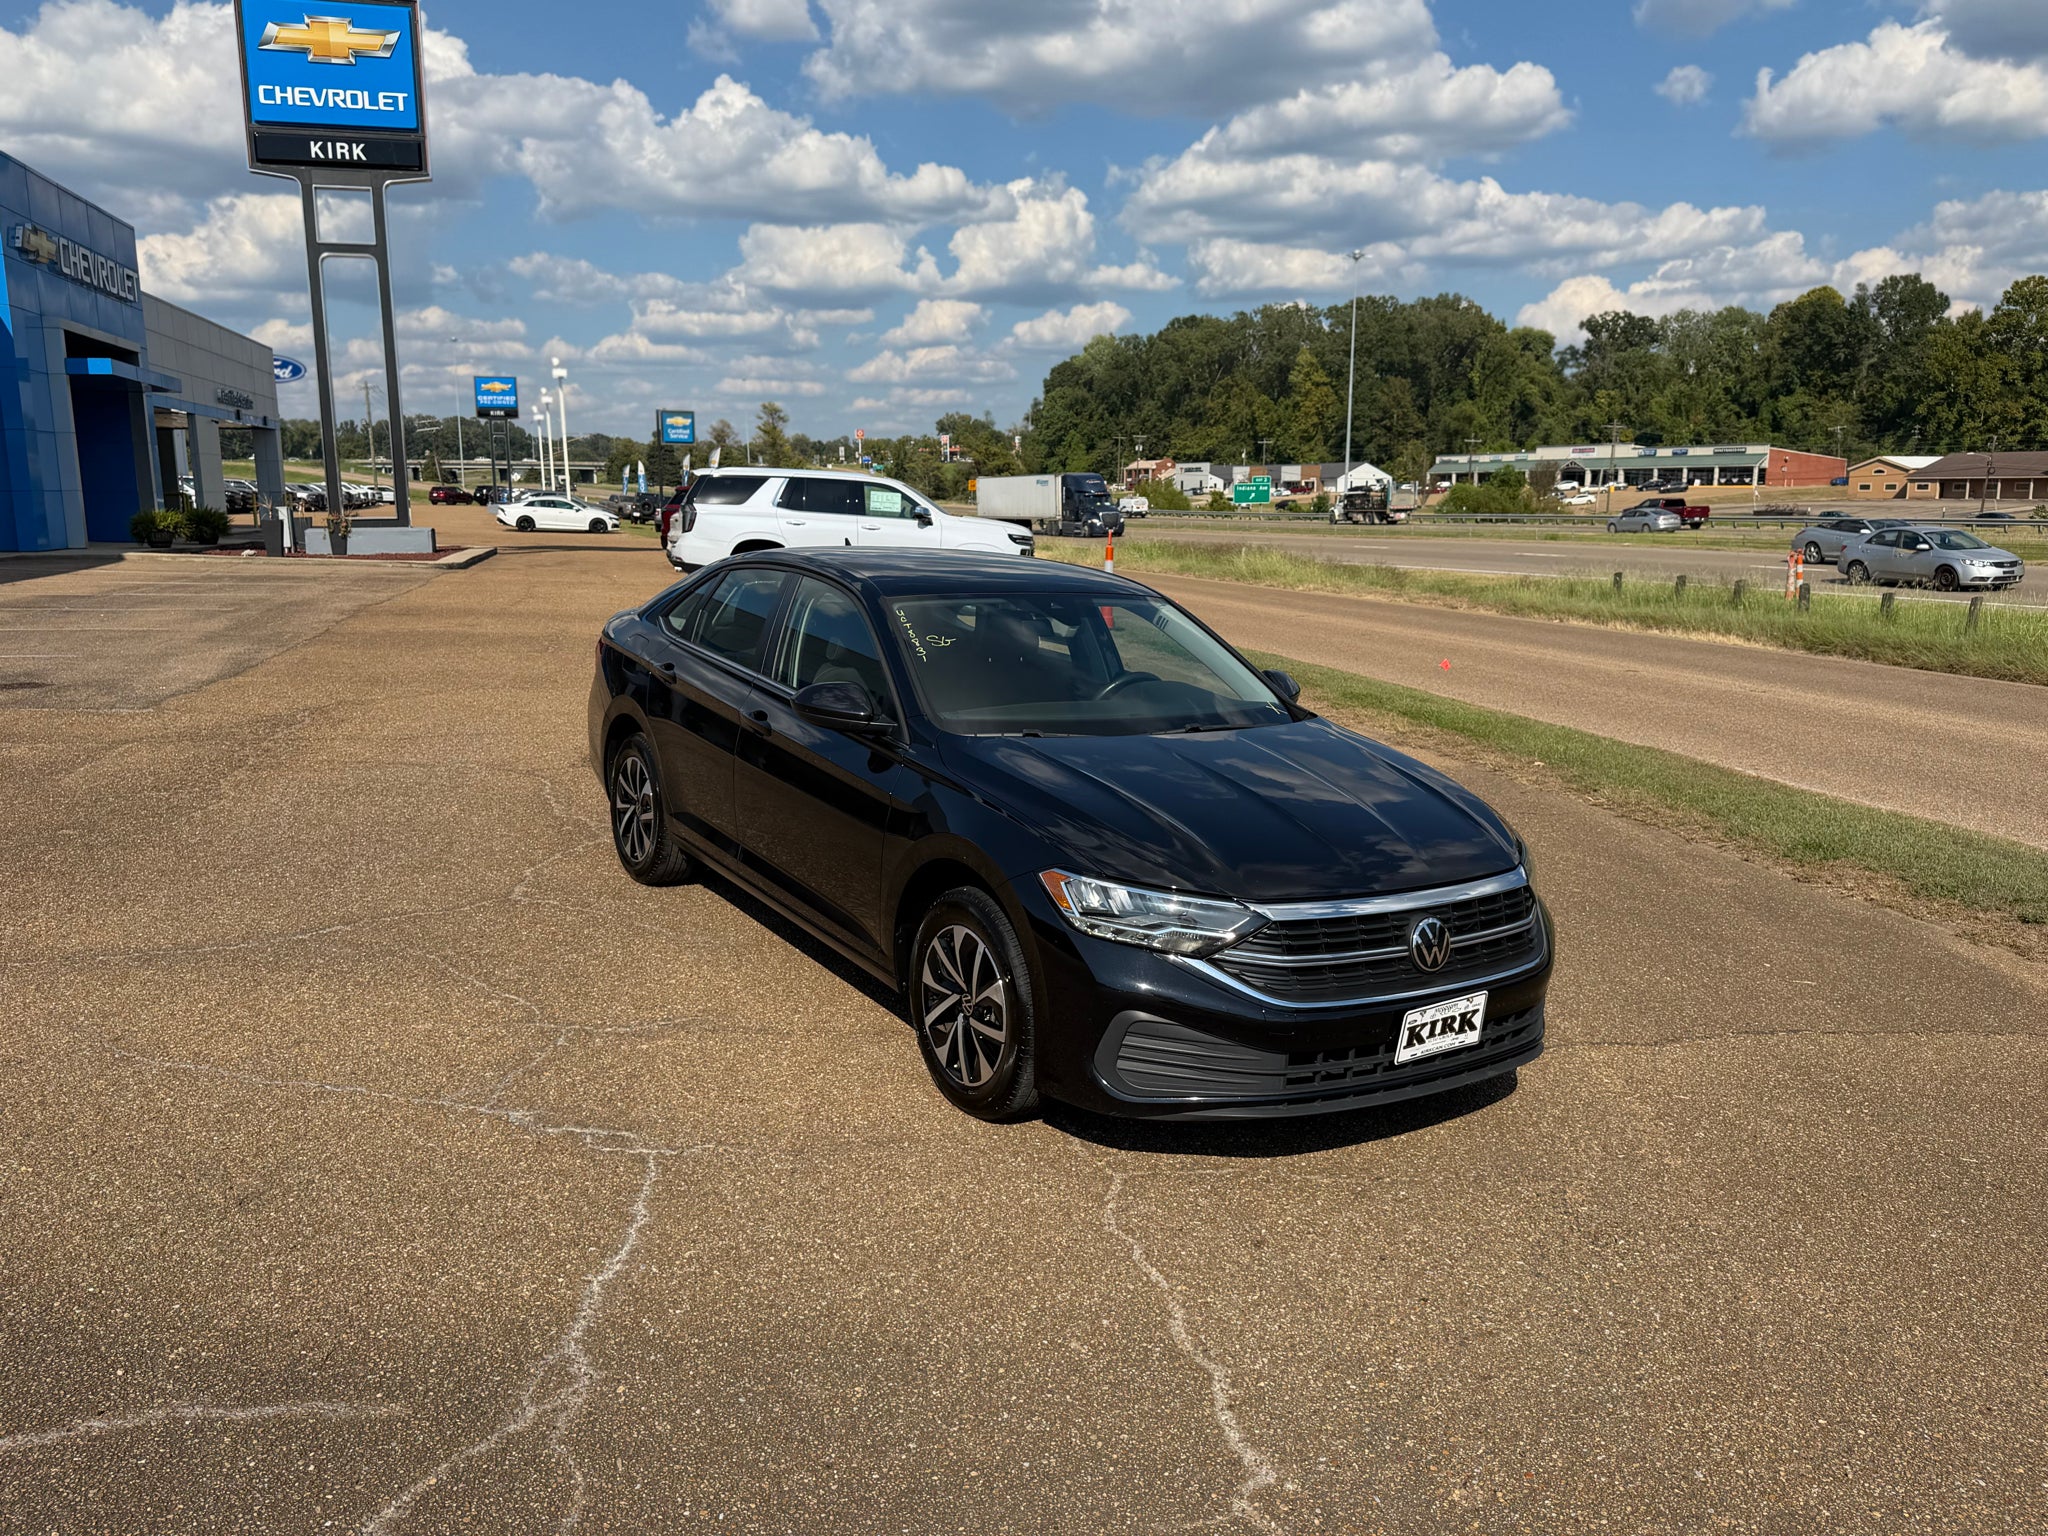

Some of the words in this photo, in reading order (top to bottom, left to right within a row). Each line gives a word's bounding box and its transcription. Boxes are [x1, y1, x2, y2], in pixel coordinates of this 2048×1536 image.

[258, 84, 408, 112] CHEVROLET
[309, 140, 367, 161] KIRK
[59, 237, 139, 302] CHEVROLET
[1402, 1008, 1480, 1050] KIRK
